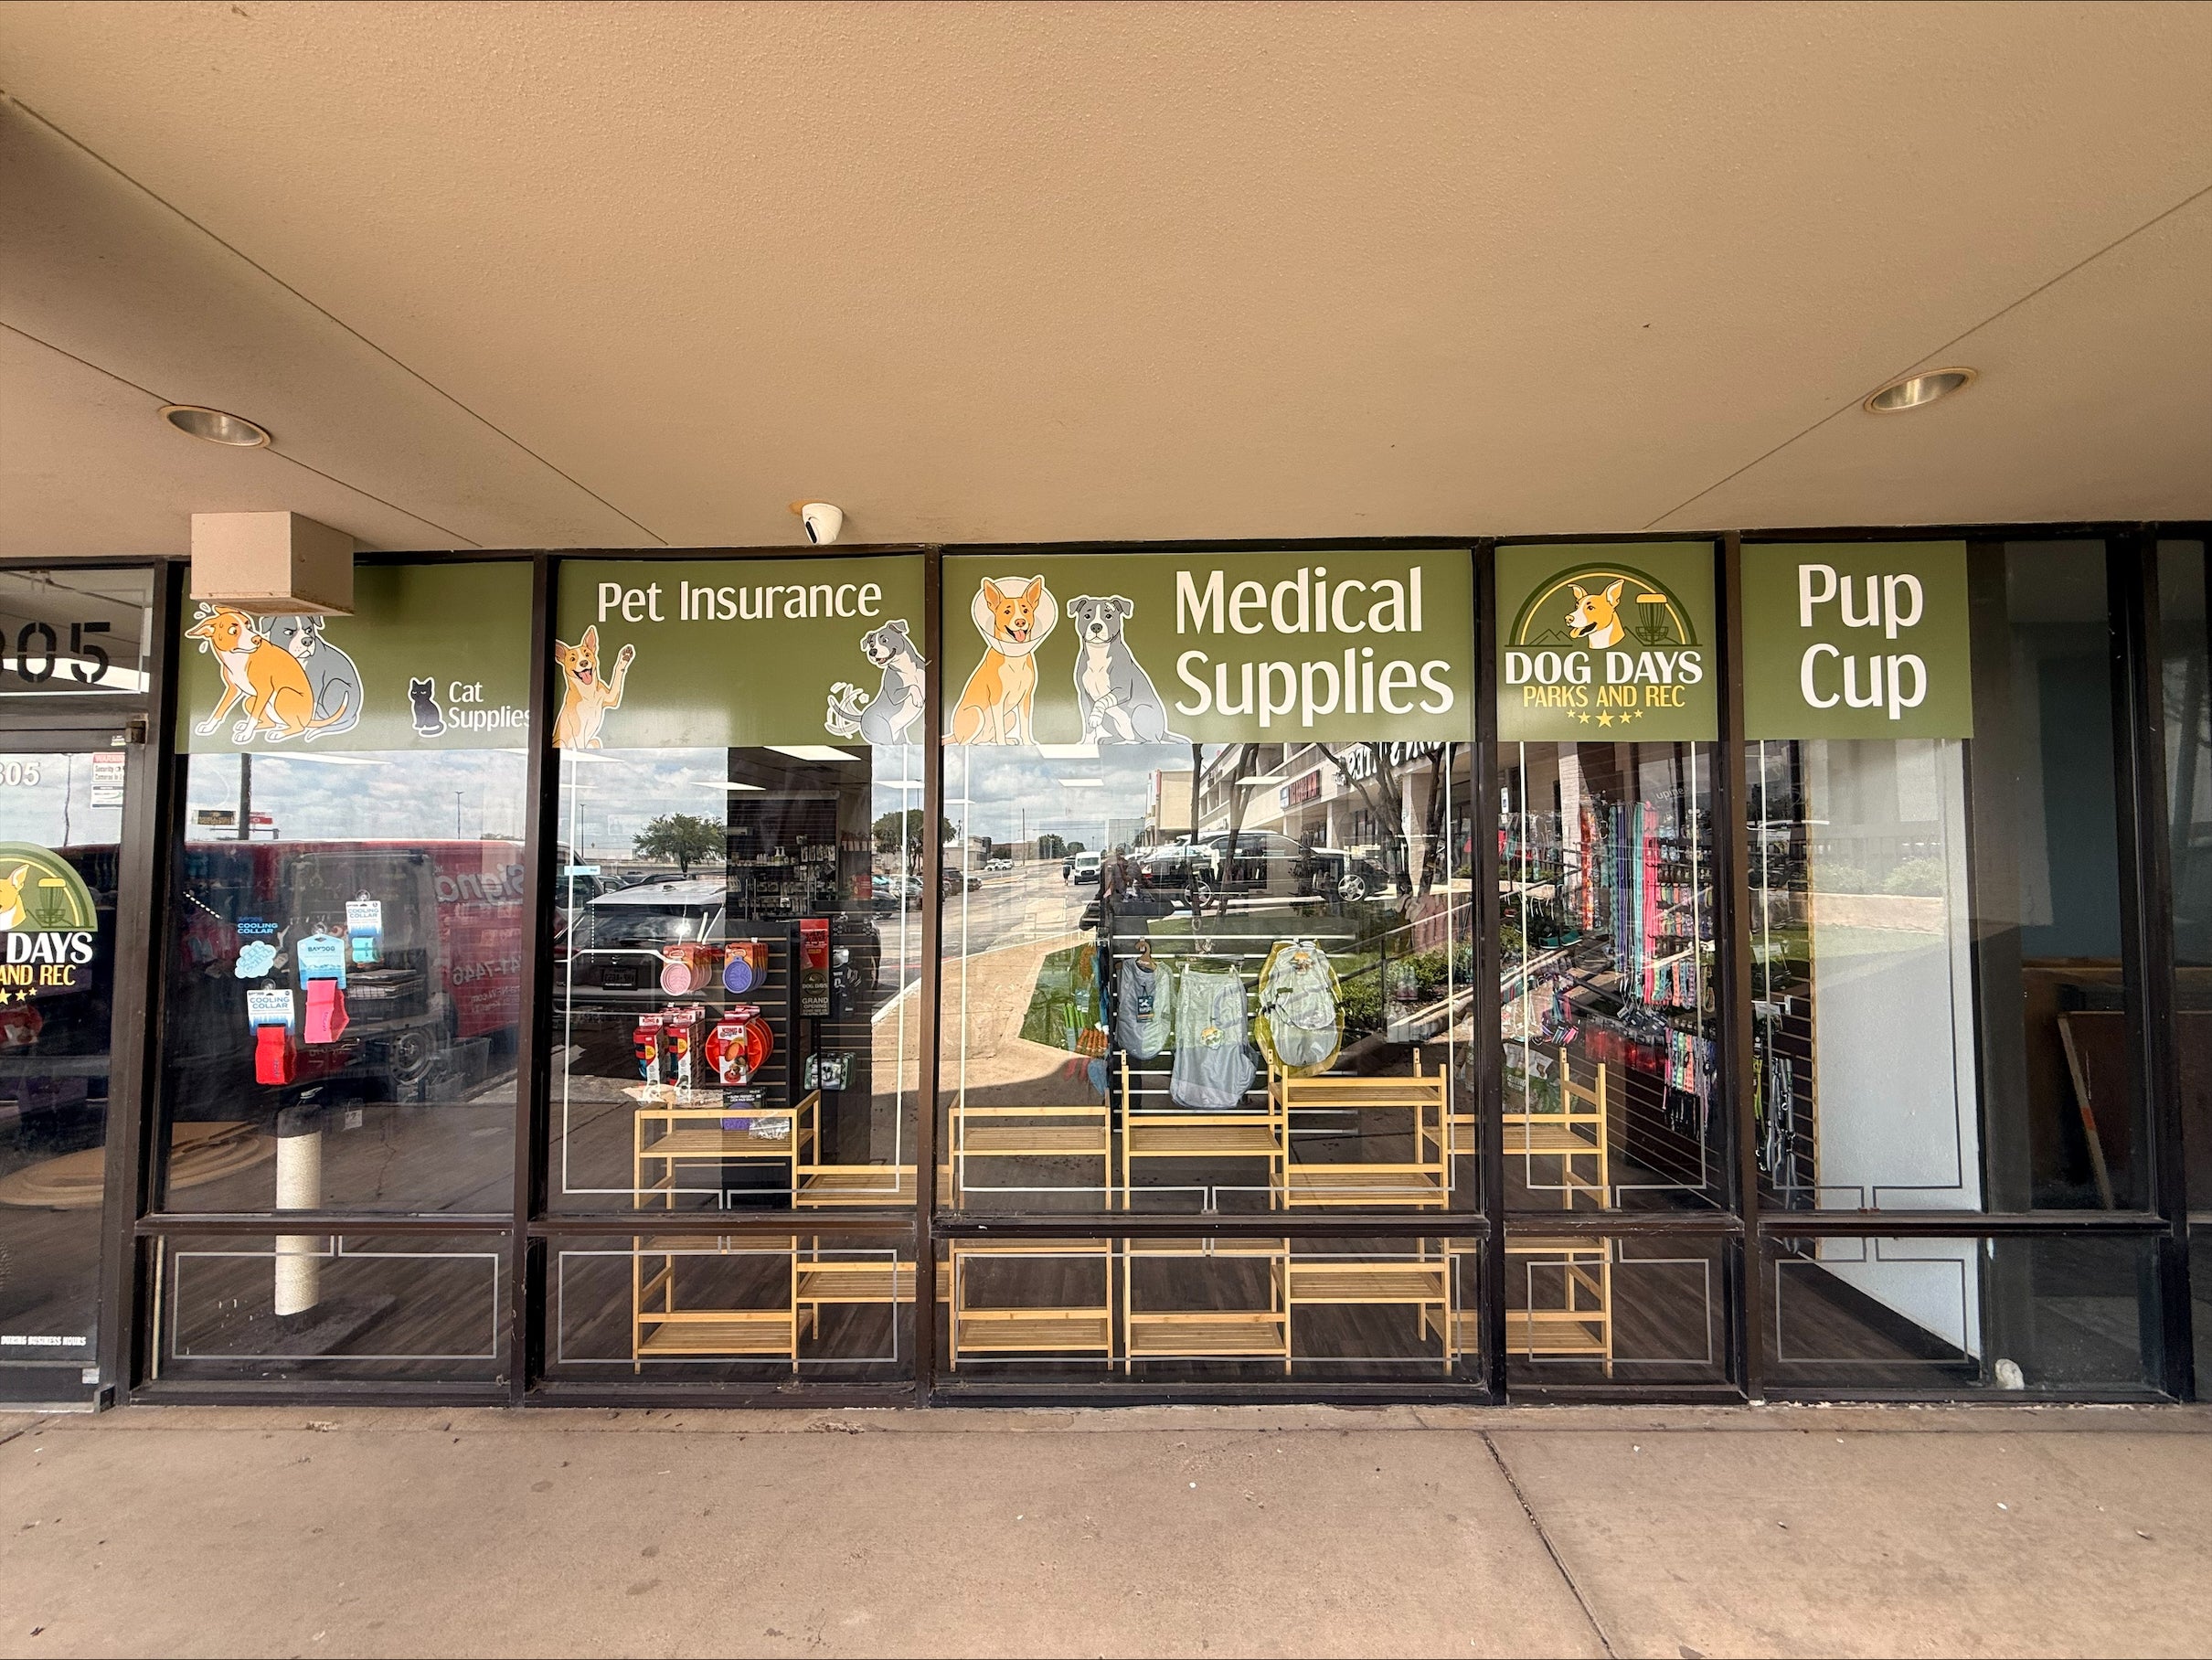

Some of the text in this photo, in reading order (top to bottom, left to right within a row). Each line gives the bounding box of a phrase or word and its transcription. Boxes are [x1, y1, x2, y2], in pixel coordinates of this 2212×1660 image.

[597, 580, 882, 622] Pet Insurance
[1175, 566, 1423, 635] Medical
[1798, 563, 1924, 639] Pup
[0, 622, 111, 684] 05
[1505, 650, 1704, 685] DOG DAYS
[449, 681, 484, 703] Cat
[1175, 647, 1455, 728] Supplies
[1523, 685, 1686, 708] PARKS AND REC
[1801, 643, 1928, 720] Cup
[0, 761, 41, 787] 05
[6, 931, 93, 964] DAYS
[0, 964, 77, 986] AND REC
[1, 1335, 87, 1346] DURING BUSINESS HOURS
